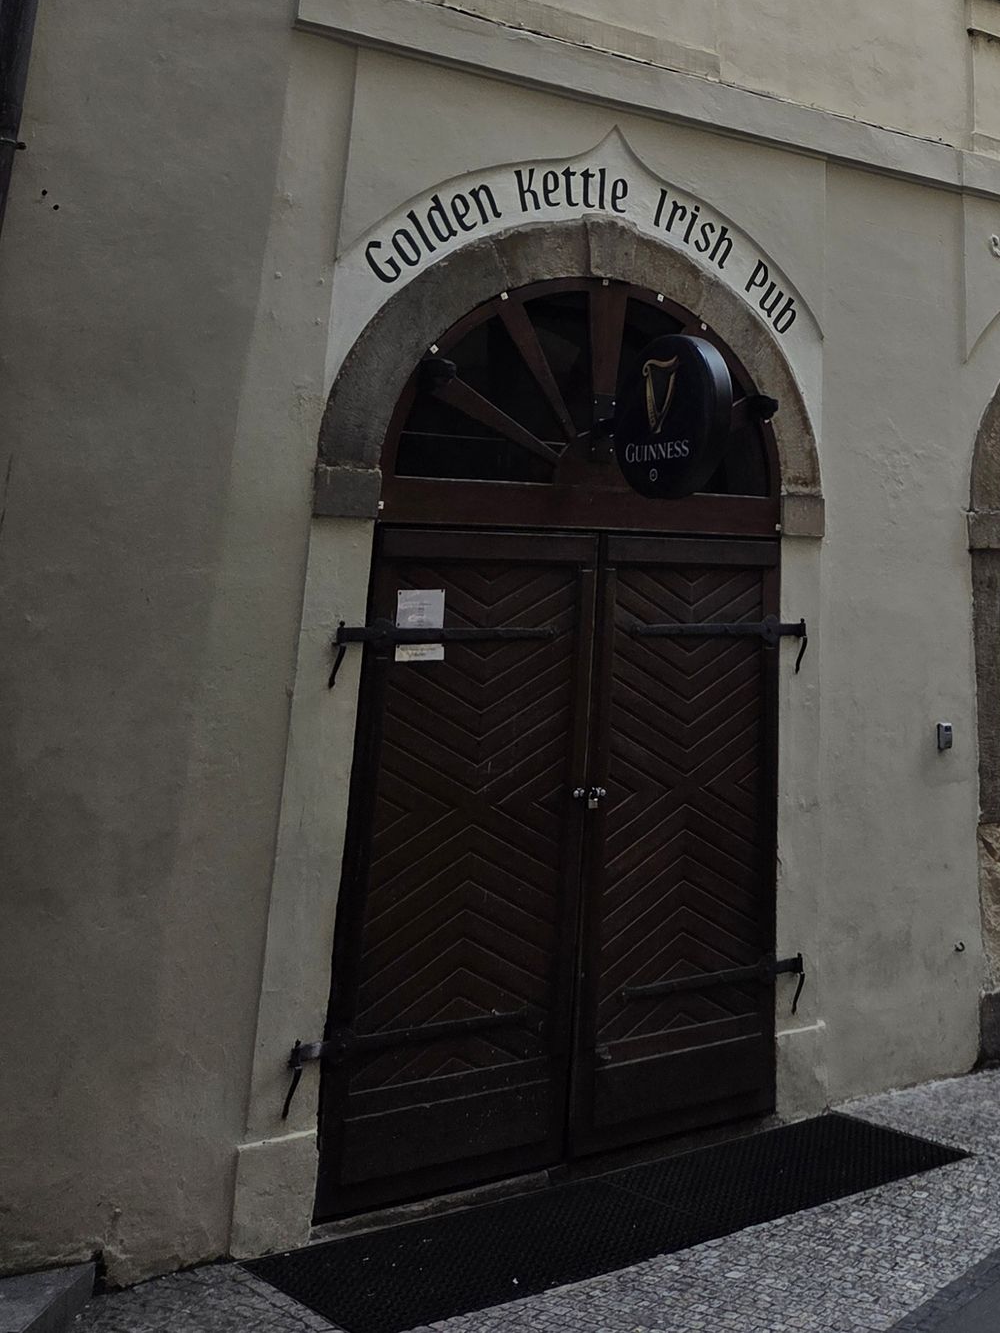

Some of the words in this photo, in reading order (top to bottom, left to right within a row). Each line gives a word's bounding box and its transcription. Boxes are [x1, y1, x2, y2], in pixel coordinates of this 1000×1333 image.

[365, 182, 502, 284] Golden
[514, 166, 629, 214] Kettle
[653, 188, 734, 269] Irish
[745, 259, 798, 335] Pub
[624, 439, 690, 464] GUINNESS
